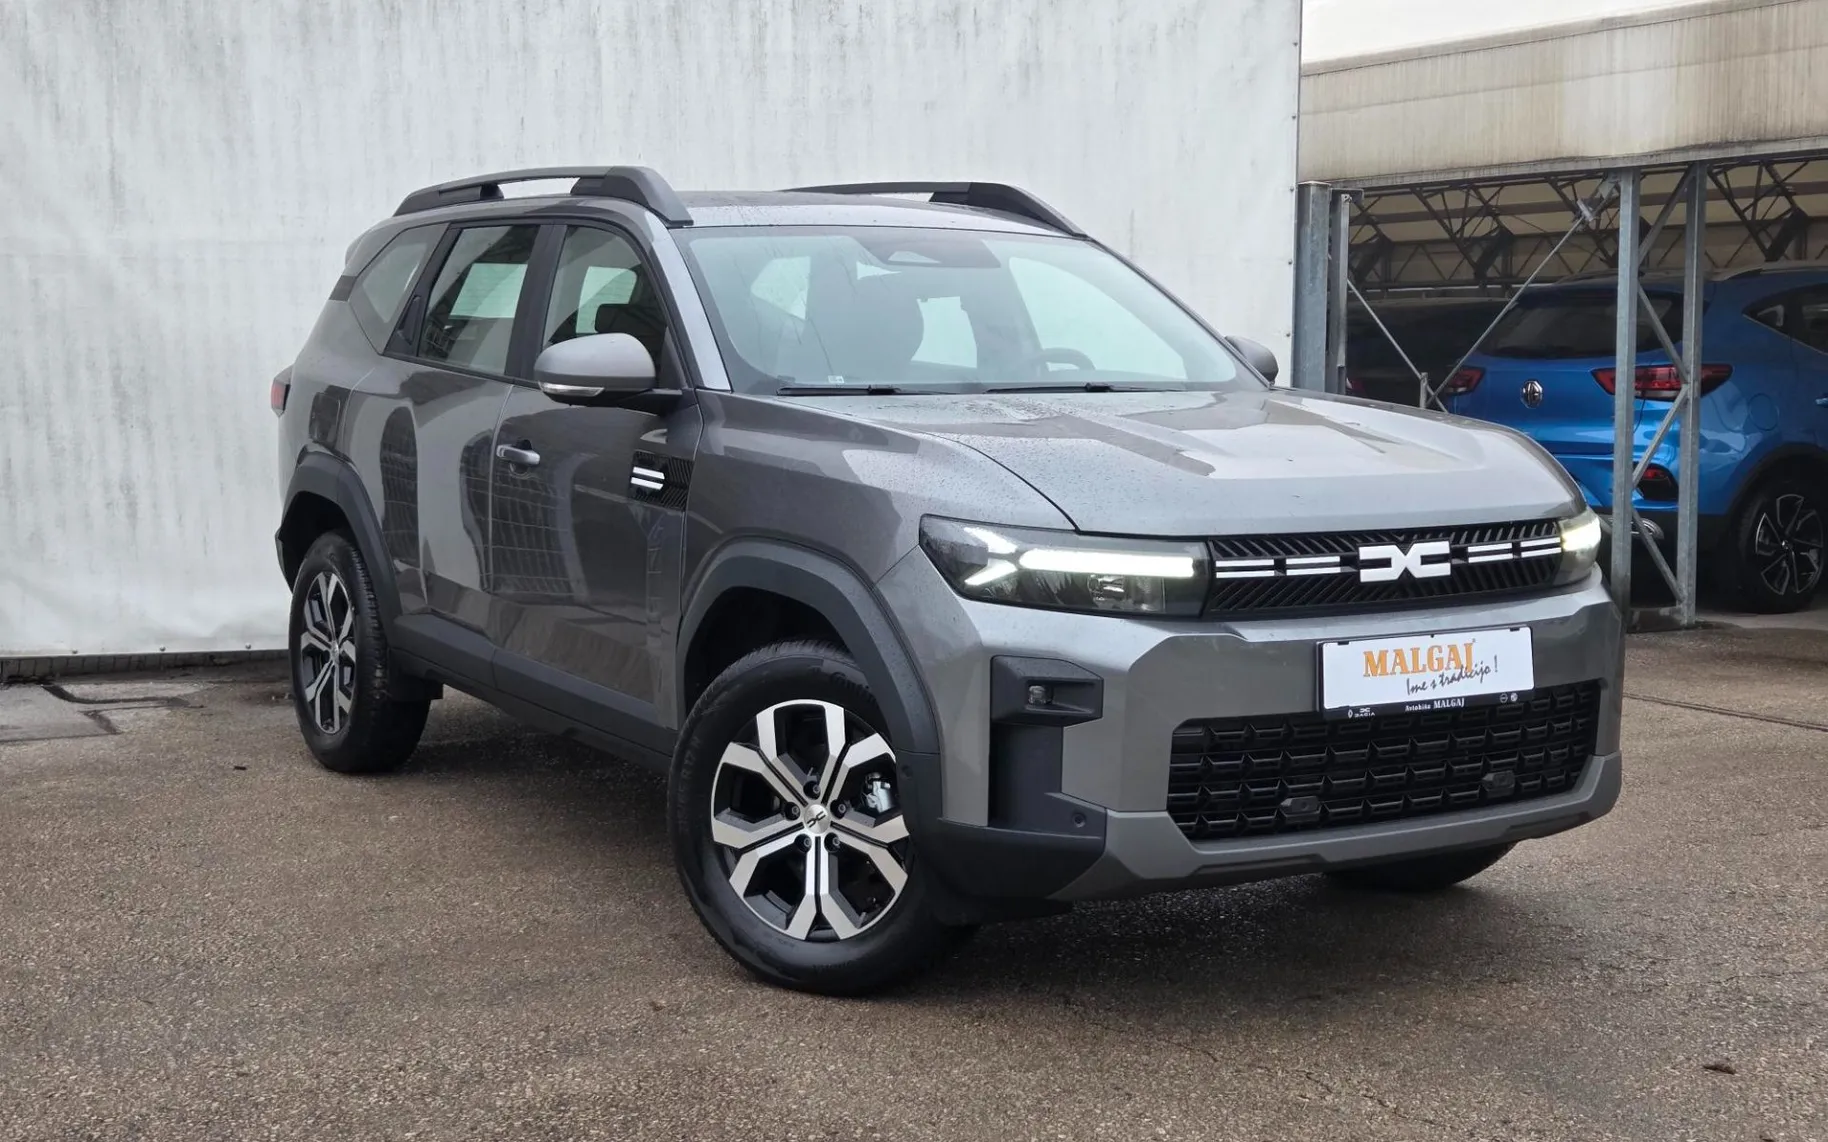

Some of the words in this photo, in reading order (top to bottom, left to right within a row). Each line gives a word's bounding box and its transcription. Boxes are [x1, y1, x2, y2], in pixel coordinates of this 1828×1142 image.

[1363, 642, 1474, 677] MALGAJ
[1406, 678, 1428, 696] Ime
[1433, 698, 1465, 709] MALGAJ
